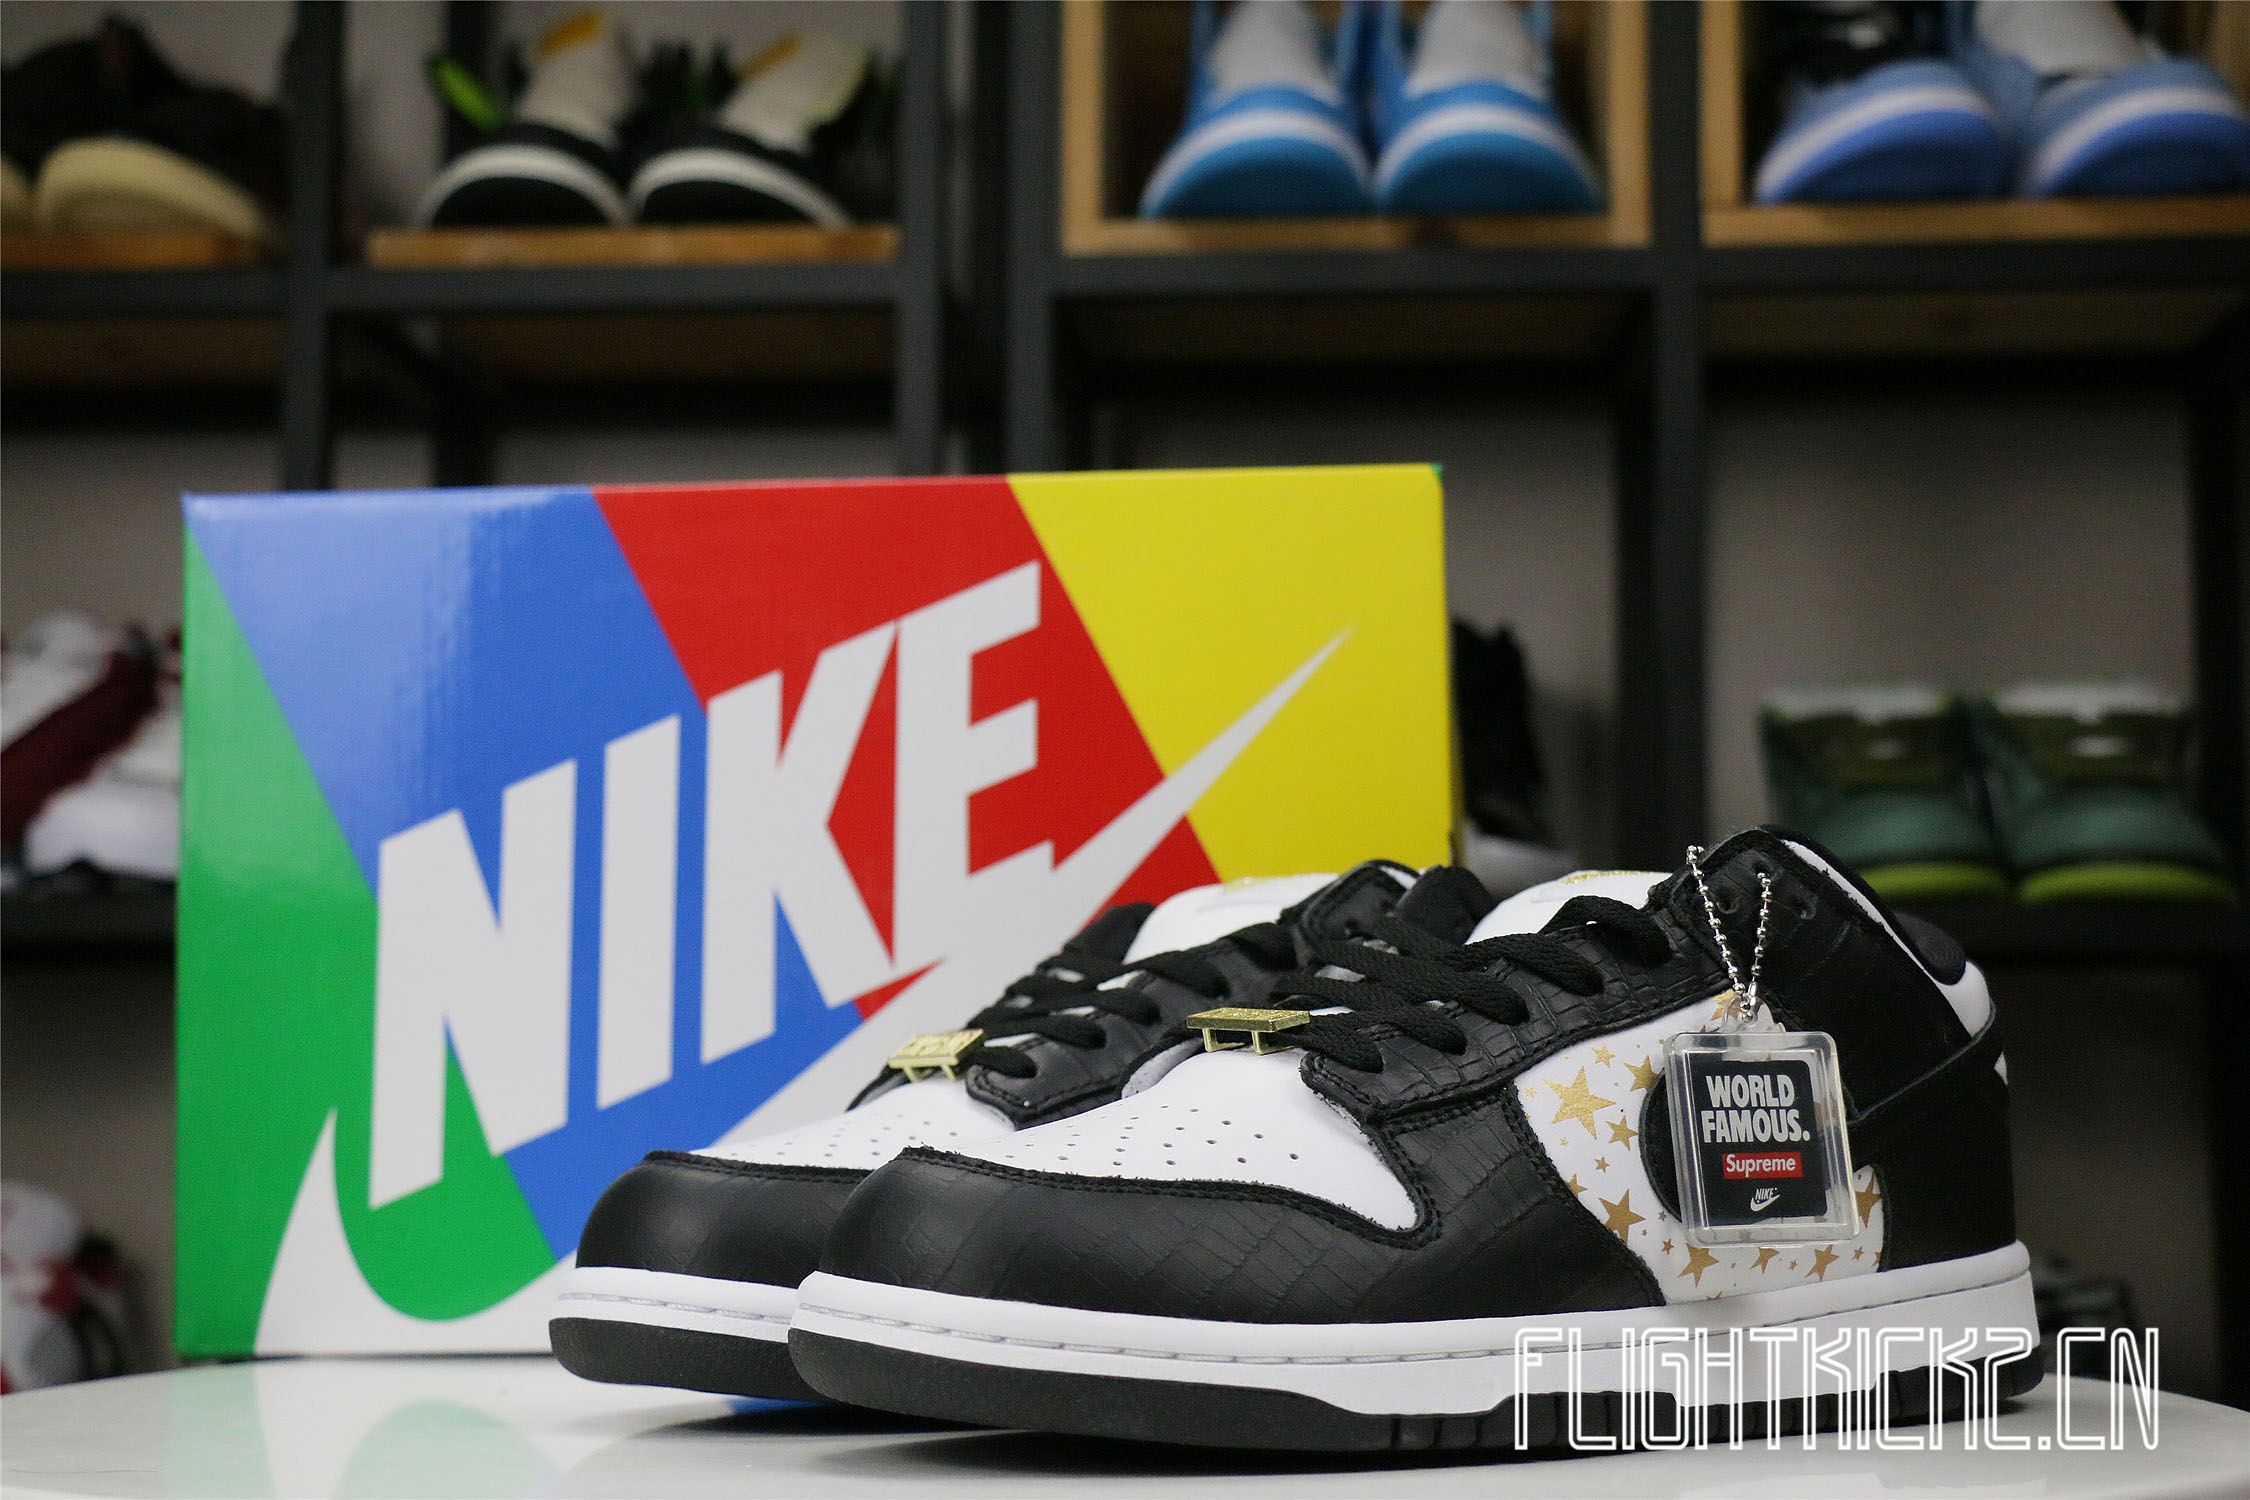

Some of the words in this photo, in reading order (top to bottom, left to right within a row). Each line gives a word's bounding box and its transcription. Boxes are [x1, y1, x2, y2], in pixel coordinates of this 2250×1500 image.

[369, 559, 1055, 1210] NIKE
[1706, 1074, 1795, 1108] WORLD
[1701, 1108, 1811, 1143] FAMOUS.
[1726, 1154, 1796, 1177] Supreme
[1754, 1188, 1775, 1201] NIKE
